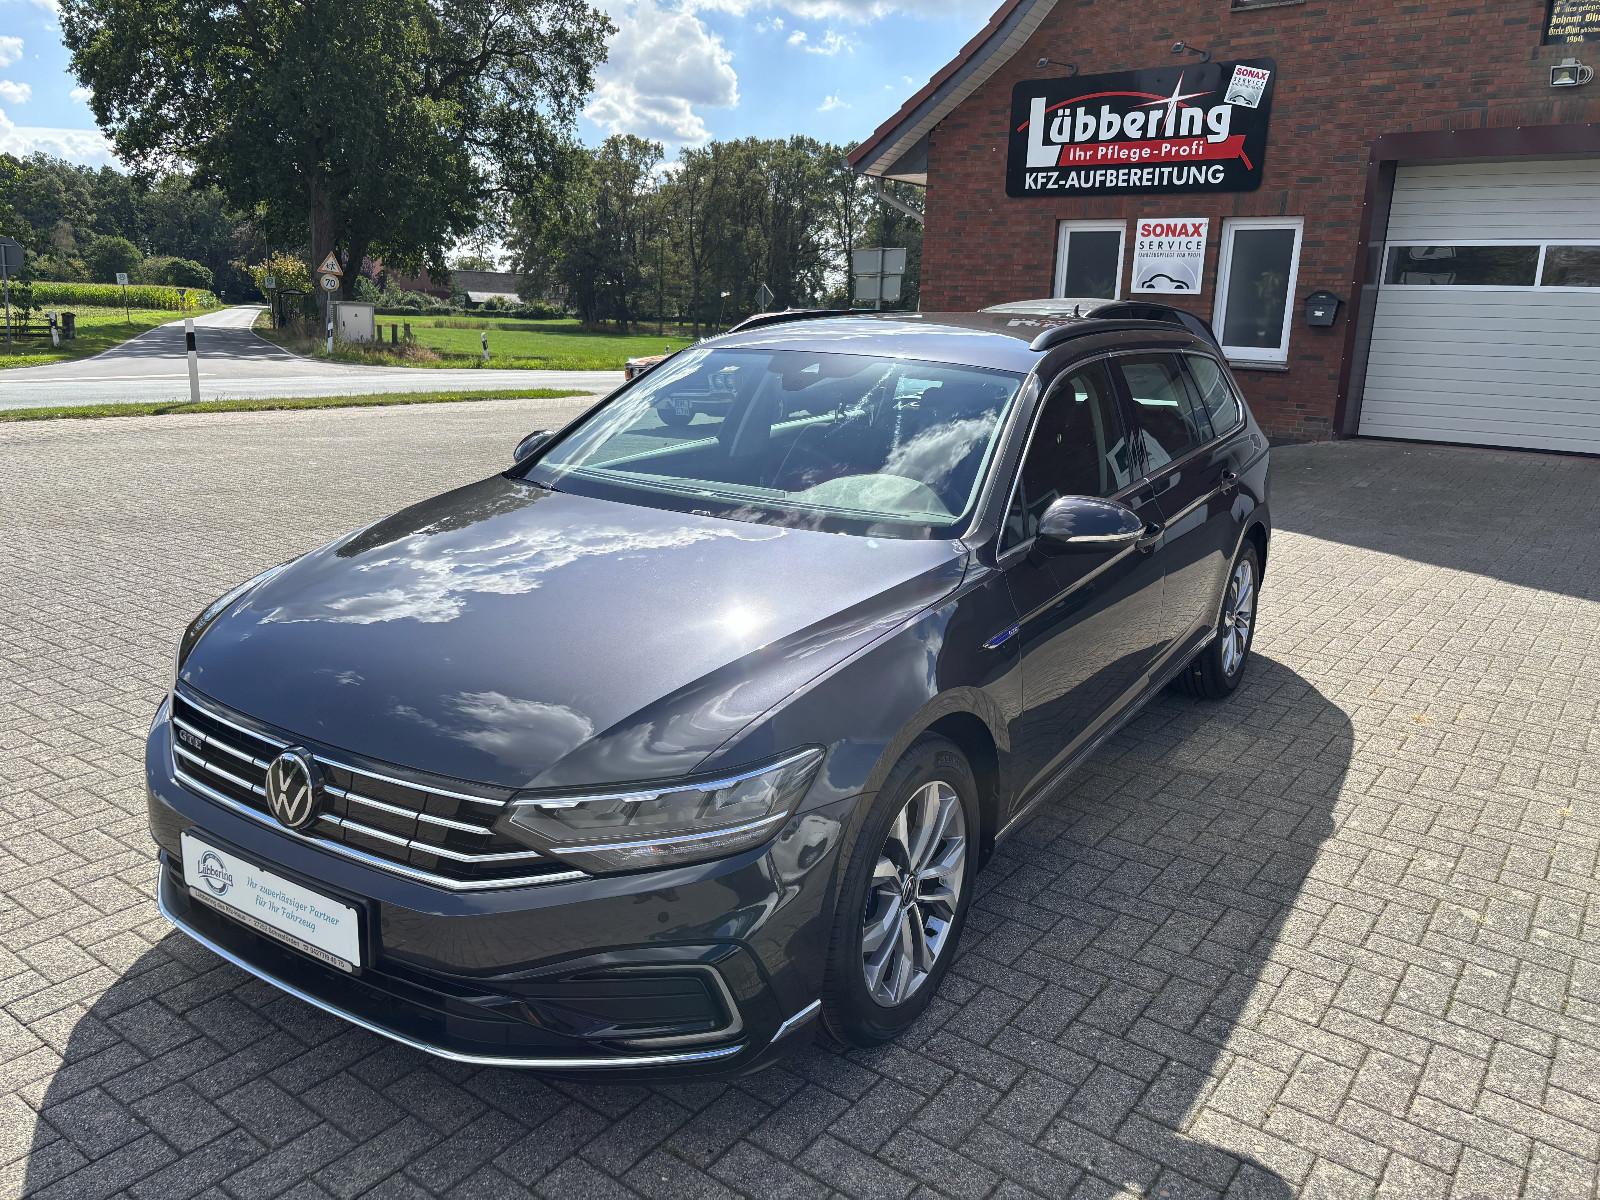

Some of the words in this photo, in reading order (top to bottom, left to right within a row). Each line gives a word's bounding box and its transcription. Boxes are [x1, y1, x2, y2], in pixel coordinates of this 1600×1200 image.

[1236, 67, 1267, 81] SONAX
[1026, 96, 1232, 168] Lübbering
[1069, 147, 1093, 161] Ihr
[1024, 165, 1225, 190] KFZ-AUFBEREITUNG
[1140, 223, 1203, 238] SONAX
[1139, 240, 1202, 250] SERVICE
[325, 278, 336, 288] 70
[179, 729, 202, 750] GTE
[197, 859, 233, 887] Lübbering
[246, 875, 258, 889] Ihr
[259, 885, 308, 912] zuverlässiger
[309, 905, 340, 926] Partner
[255, 894, 267, 908] für
[268, 900, 280, 913] Ihr
[281, 906, 316, 933] Fahrzeug
